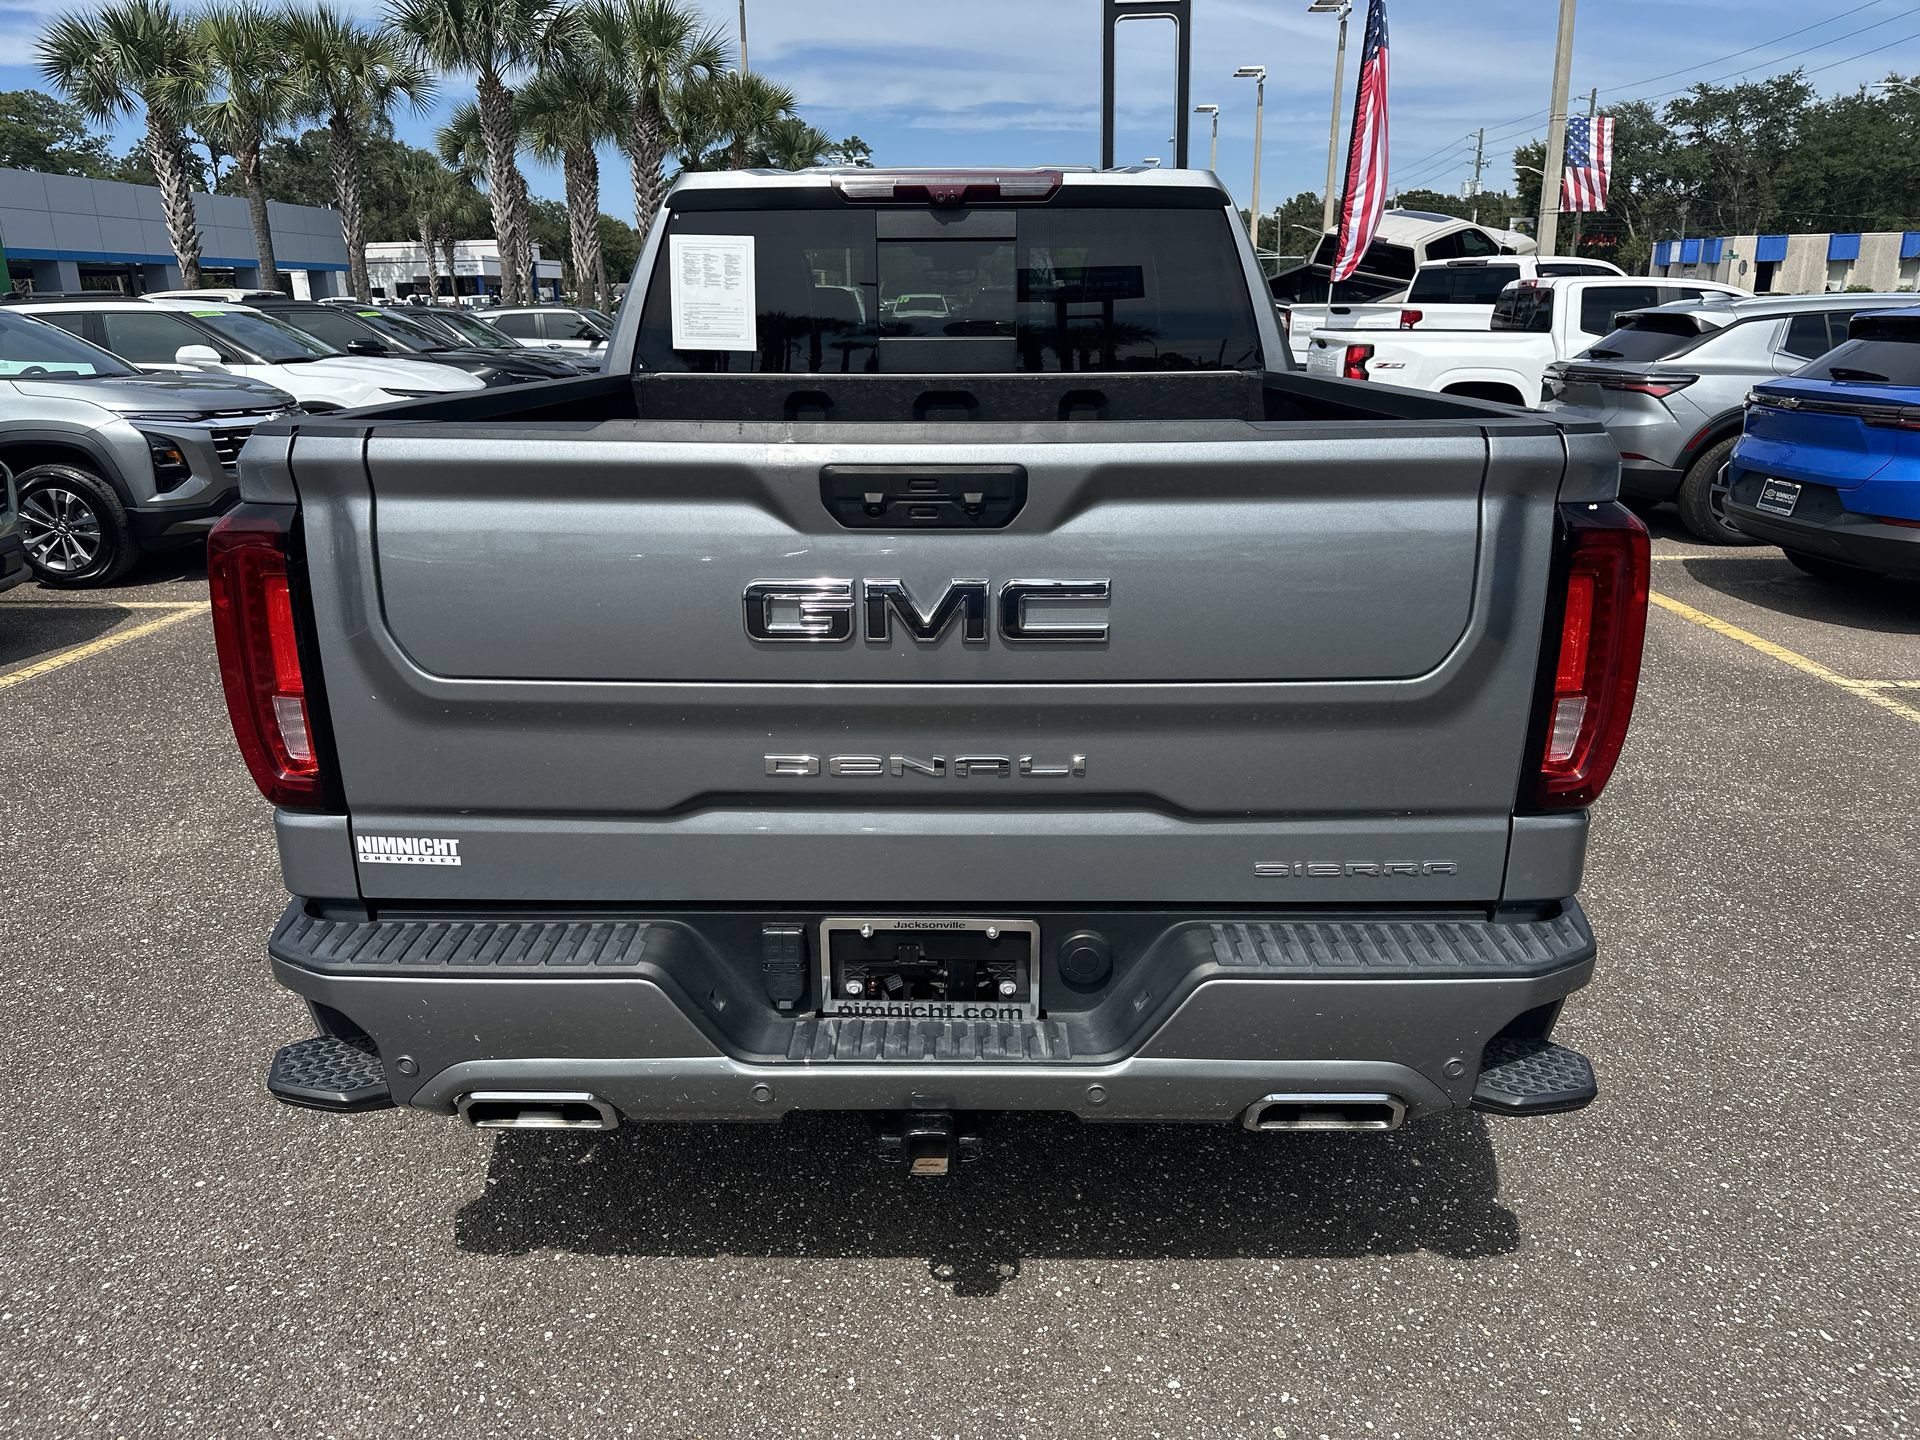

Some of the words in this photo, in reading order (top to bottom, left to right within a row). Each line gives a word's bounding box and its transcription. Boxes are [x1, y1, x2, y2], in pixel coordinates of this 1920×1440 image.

[744, 578, 1111, 642] GMC
[764, 754, 1086, 776] DENALI
[356, 836, 459, 856] NIMNICHT
[363, 855, 456, 863] CHEVROLET
[1254, 861, 1458, 877] SIERRA
[894, 921, 966, 929] Jacksonville
[838, 1003, 1023, 1019] nimnicht.com
